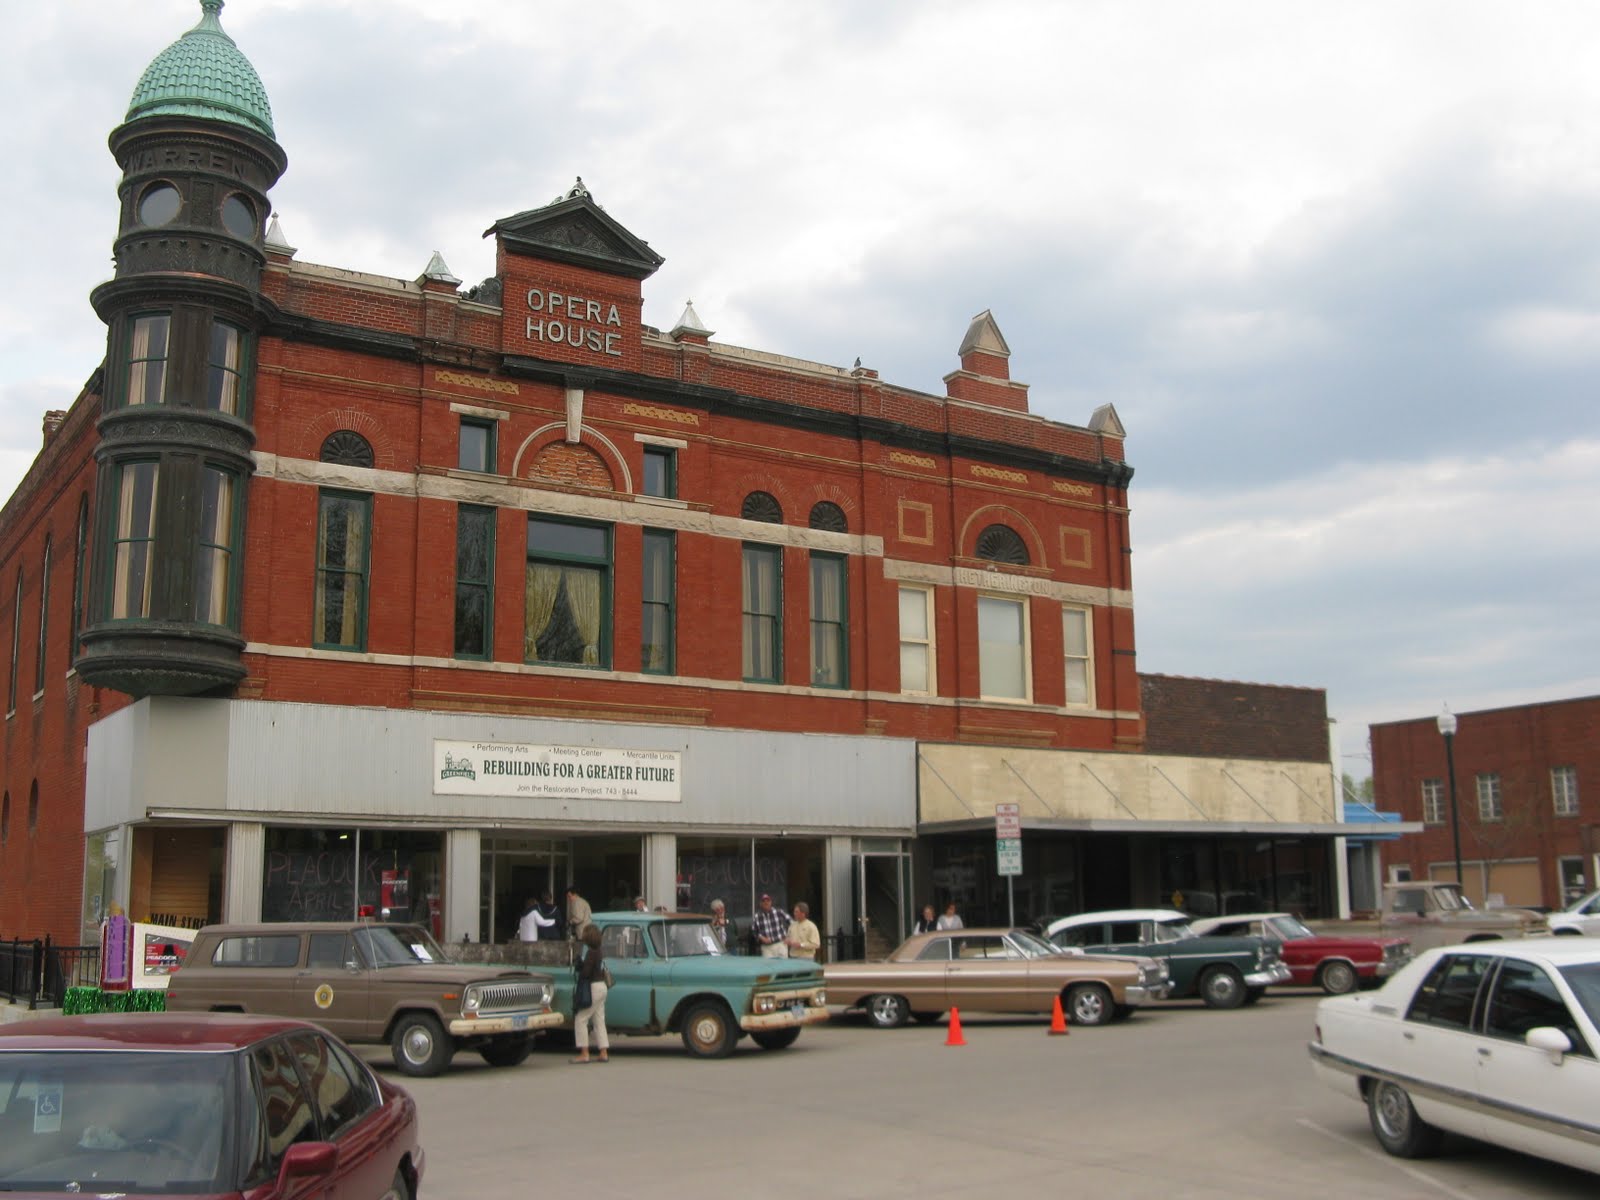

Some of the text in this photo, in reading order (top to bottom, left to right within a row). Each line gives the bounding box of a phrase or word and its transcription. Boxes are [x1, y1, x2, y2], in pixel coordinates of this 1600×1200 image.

[129, 150, 247, 179] WARREN
[527, 288, 621, 327] OPERA
[526, 316, 621, 355] HOUSE
[959, 570, 1048, 595] HETHERINGTON
[476, 743, 529, 754] Performing Arts
[553, 747, 602, 757] Meeting Center
[626, 751, 675, 760] Mercantile Units
[483, 759, 675, 783] REBUILDING FOR A GREATER FUTURE
[517, 784, 530, 792] Join
[531, 784, 542, 792] the
[543, 784, 579, 793] Restoration
[580, 786, 602, 795] Project
[605, 787, 617, 795] 743
[266, 851, 380, 888] PEACOCK
[151, 913, 176, 927] MAIN
